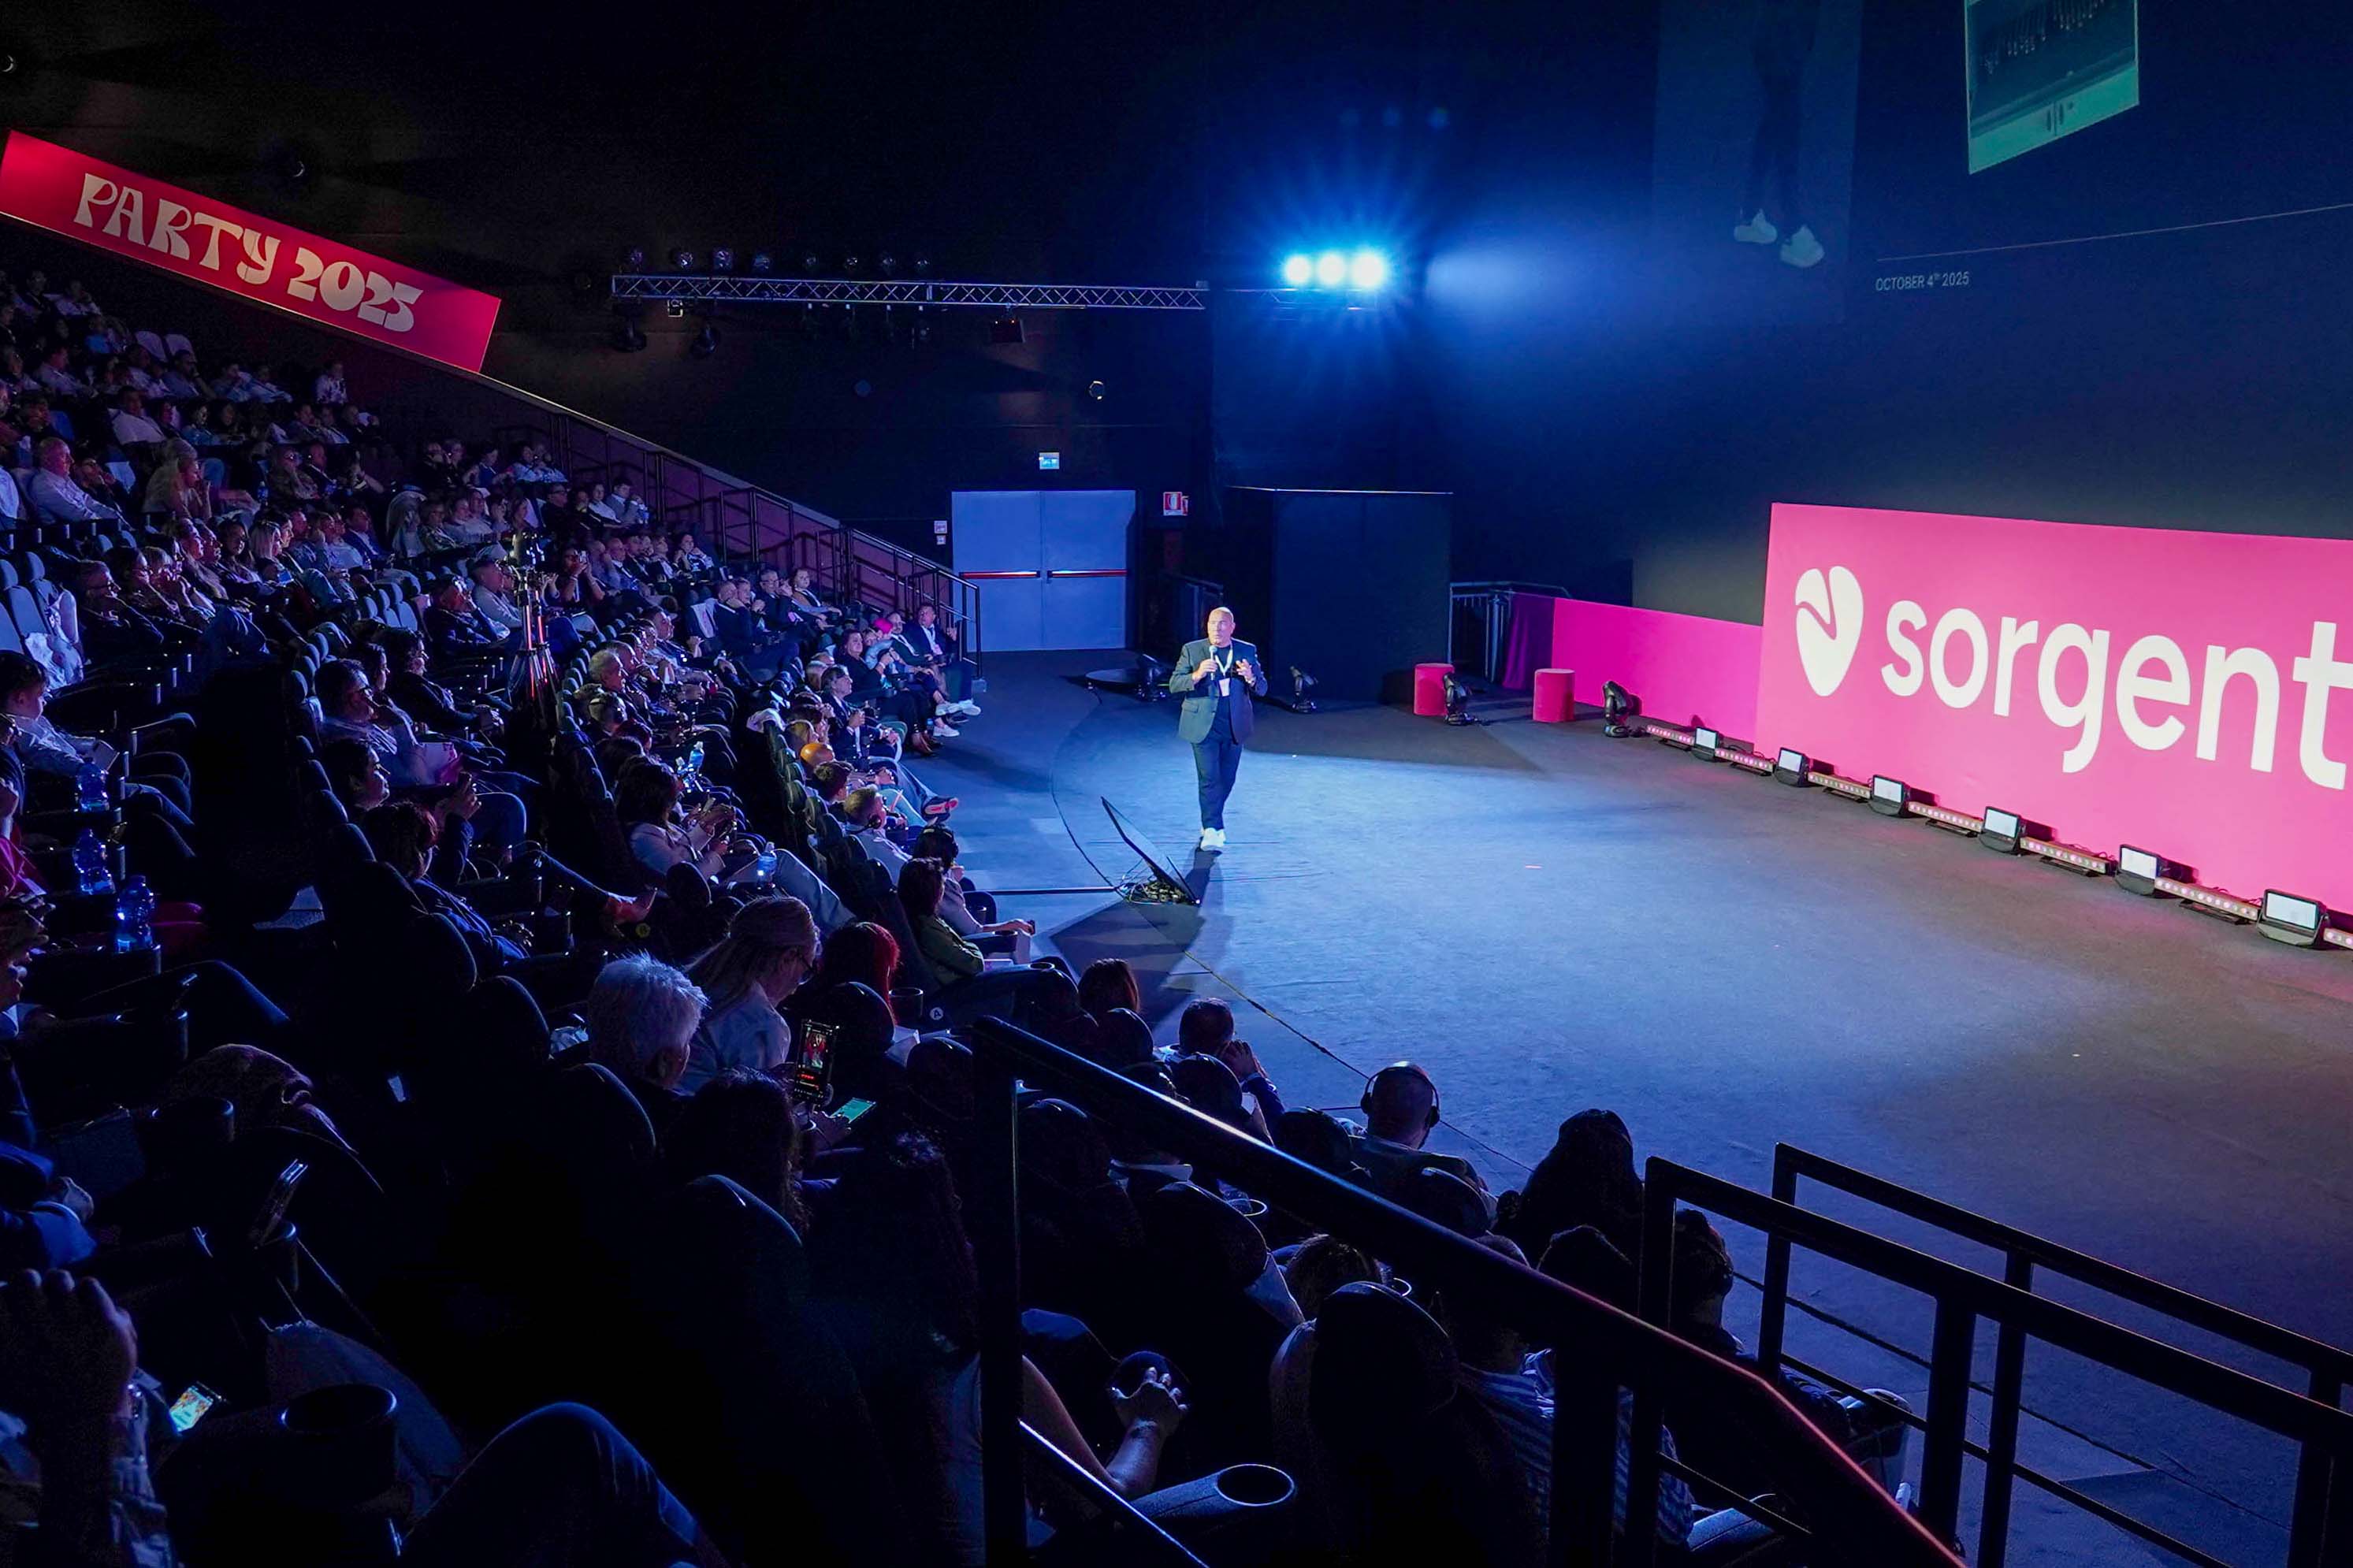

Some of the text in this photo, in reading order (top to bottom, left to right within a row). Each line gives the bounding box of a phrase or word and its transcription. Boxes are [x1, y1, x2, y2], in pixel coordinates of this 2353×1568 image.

[74, 173, 423, 332] PARTY 2025
[1875, 275, 1924, 291] OCTOBER
[1942, 271, 1969, 287] 2025
